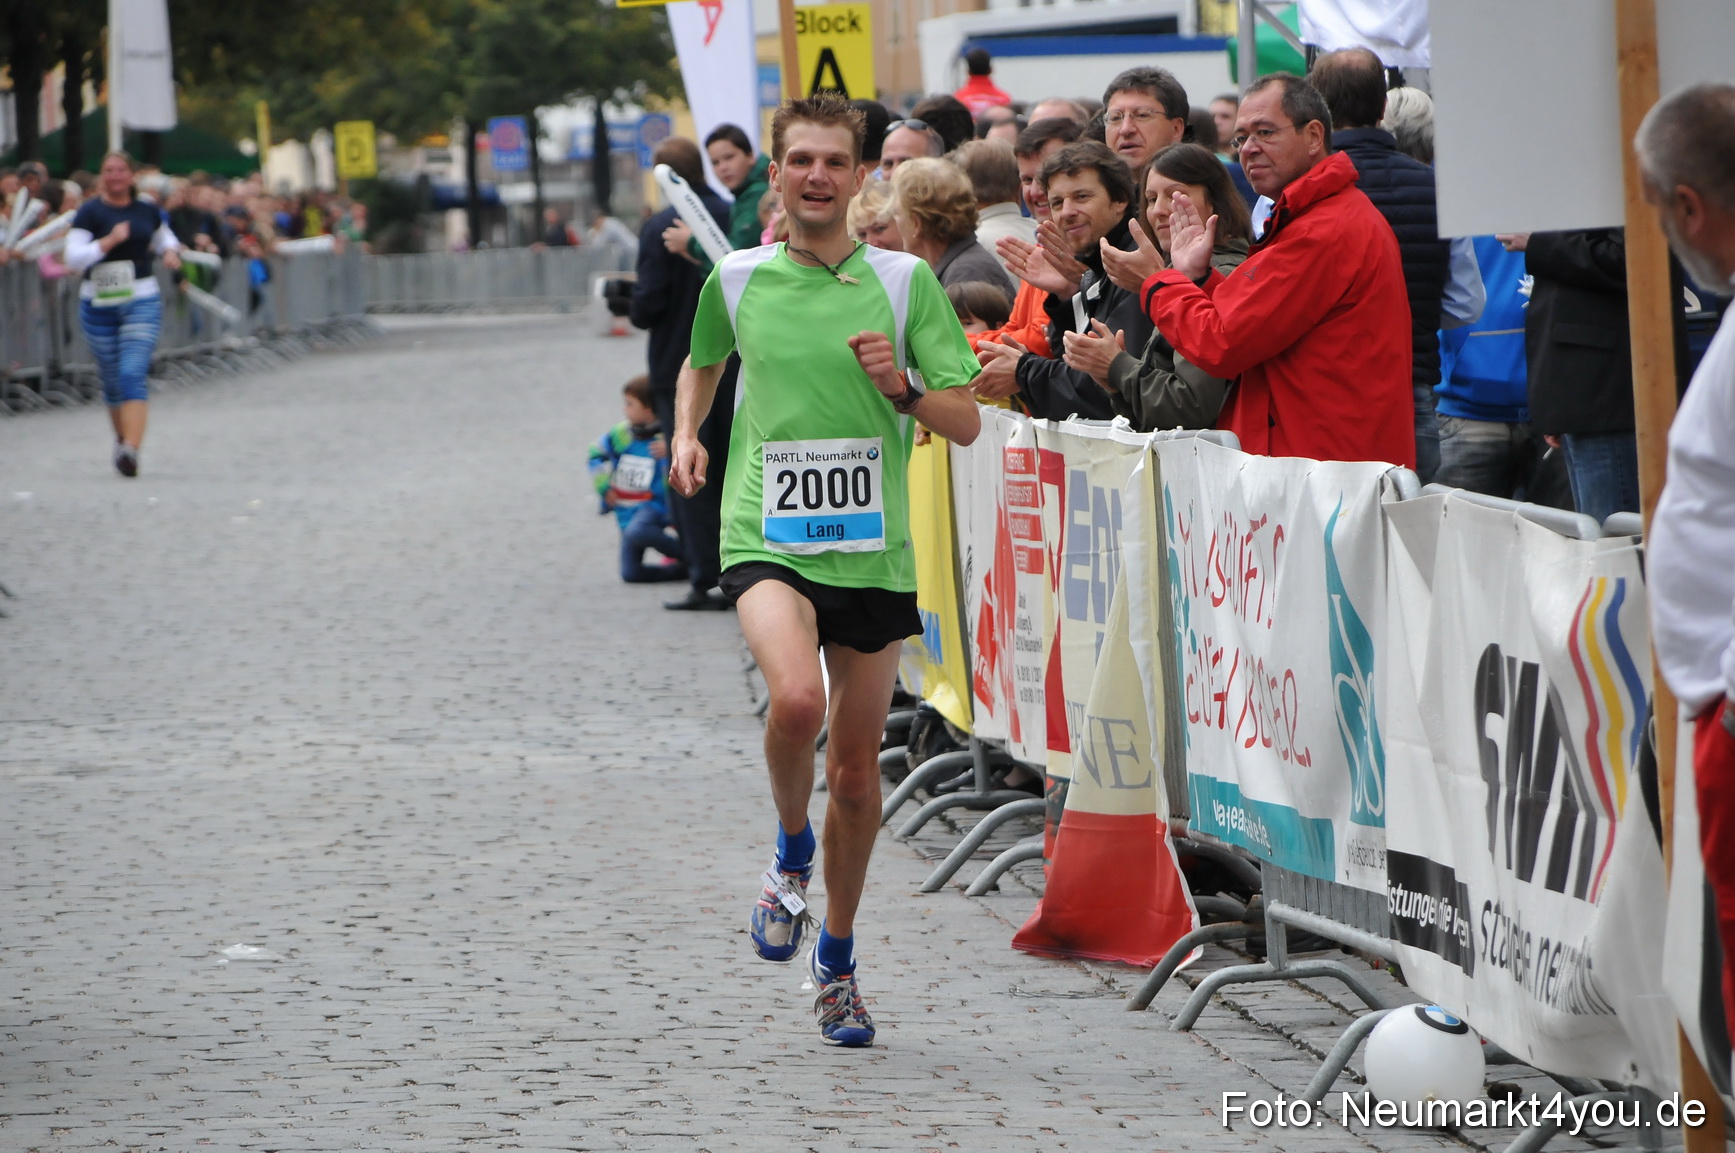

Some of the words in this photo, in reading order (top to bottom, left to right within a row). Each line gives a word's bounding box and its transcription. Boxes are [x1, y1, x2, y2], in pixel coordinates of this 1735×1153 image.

[795, 8, 862, 34] Block
[809, 47, 850, 100] A
[765, 452, 803, 463] PARTL
[806, 450, 862, 462] Neumarkt
[776, 465, 872, 511] 2000
[806, 522, 845, 540] Lang
